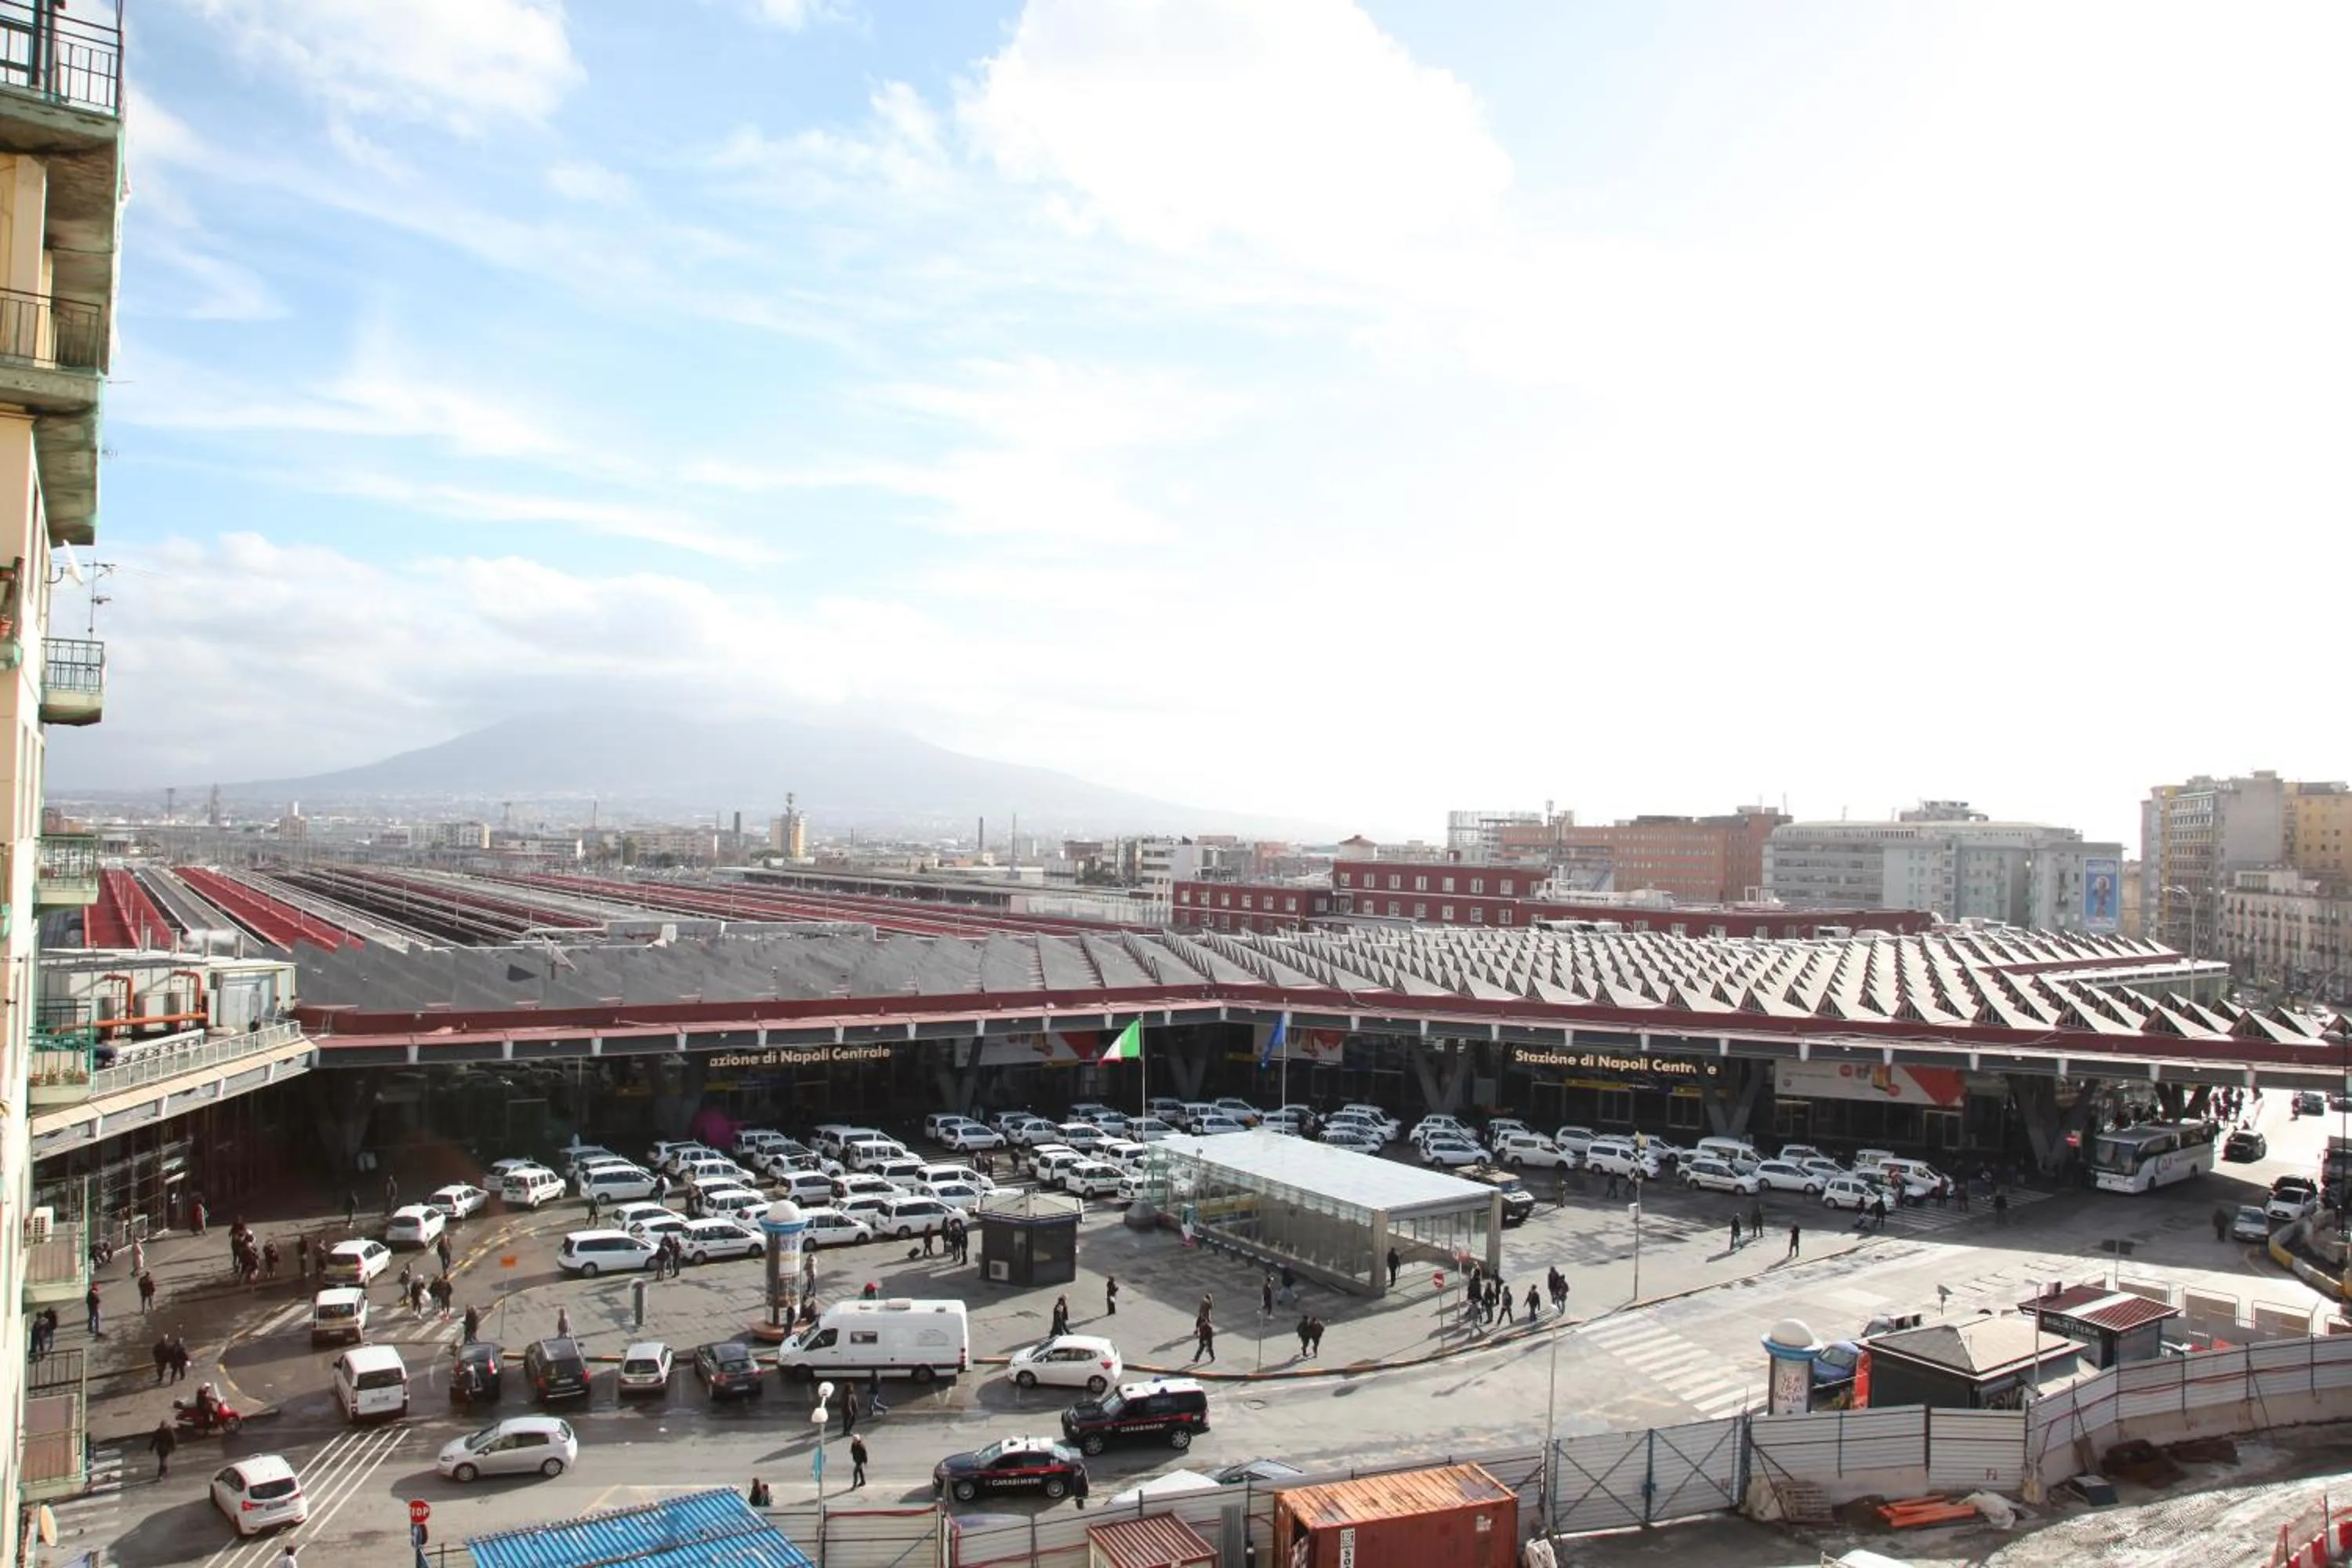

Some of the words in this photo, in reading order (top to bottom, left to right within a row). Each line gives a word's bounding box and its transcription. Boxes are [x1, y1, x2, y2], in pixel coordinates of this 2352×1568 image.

[762, 1051, 777, 1065] di
[780, 1047, 830, 1065] Napoli
[832, 1044, 891, 1060] Centrale
[1514, 1049, 1577, 1066] Stazione
[1580, 1054, 1595, 1067] di
[1597, 1055, 1648, 1072] Napoli
[1652, 1058, 1717, 1076] Centre
